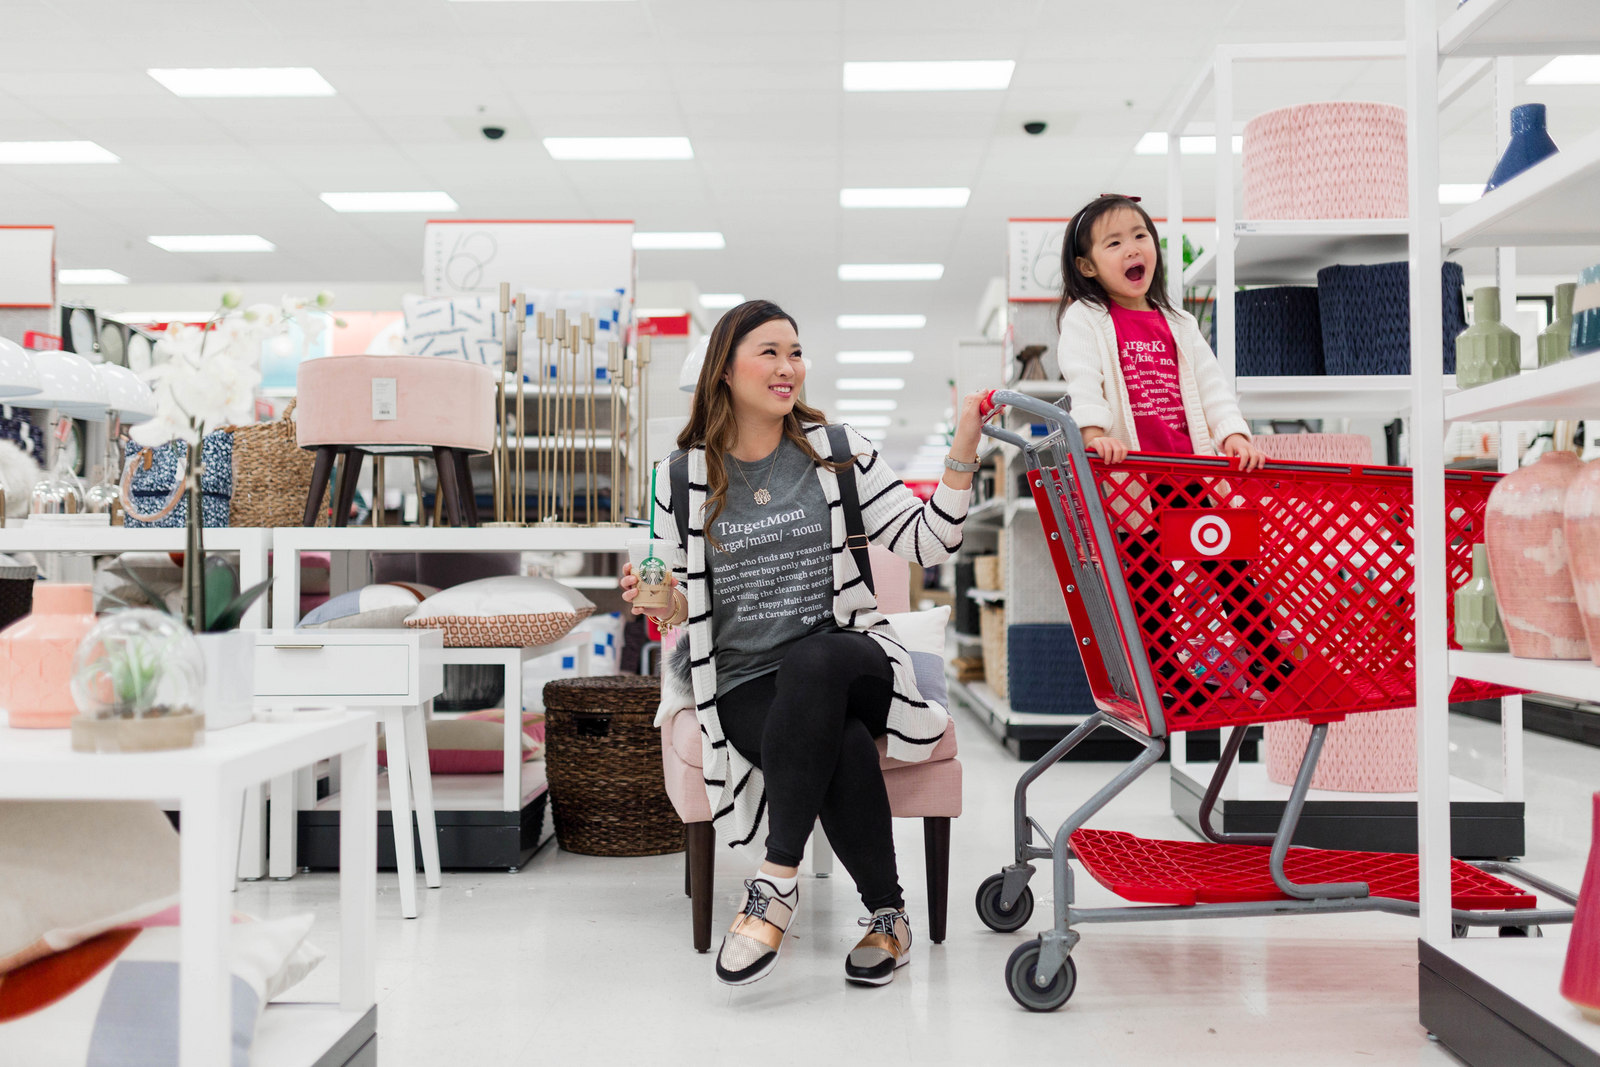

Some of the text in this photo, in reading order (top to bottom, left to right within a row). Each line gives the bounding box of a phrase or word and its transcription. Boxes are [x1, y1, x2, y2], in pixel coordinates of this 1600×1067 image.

[718, 509, 806, 536] TargetMom
[792, 523, 823, 537] noun
[740, 557, 757, 567] who
[757, 553, 779, 564] finds
[780, 550, 795, 560] any
[796, 544, 822, 556] reason
[720, 582, 744, 595] enjoys
[744, 576, 776, 589] strolling
[776, 570, 808, 584] through
[809, 564, 828, 577] every
[722, 573, 739, 583] run,
[740, 568, 760, 578] never
[761, 563, 780, 575] buys
[781, 559, 799, 571] only
[721, 594, 736, 605] and
[760, 588, 773, 598] the
[774, 583, 810, 595] clearance
[758, 598, 783, 611] Happy;
[737, 612, 758, 622] Smart
[758, 611, 765, 619] &
[765, 606, 799, 619] Cartwheel
[798, 603, 824, 614] Genius.
